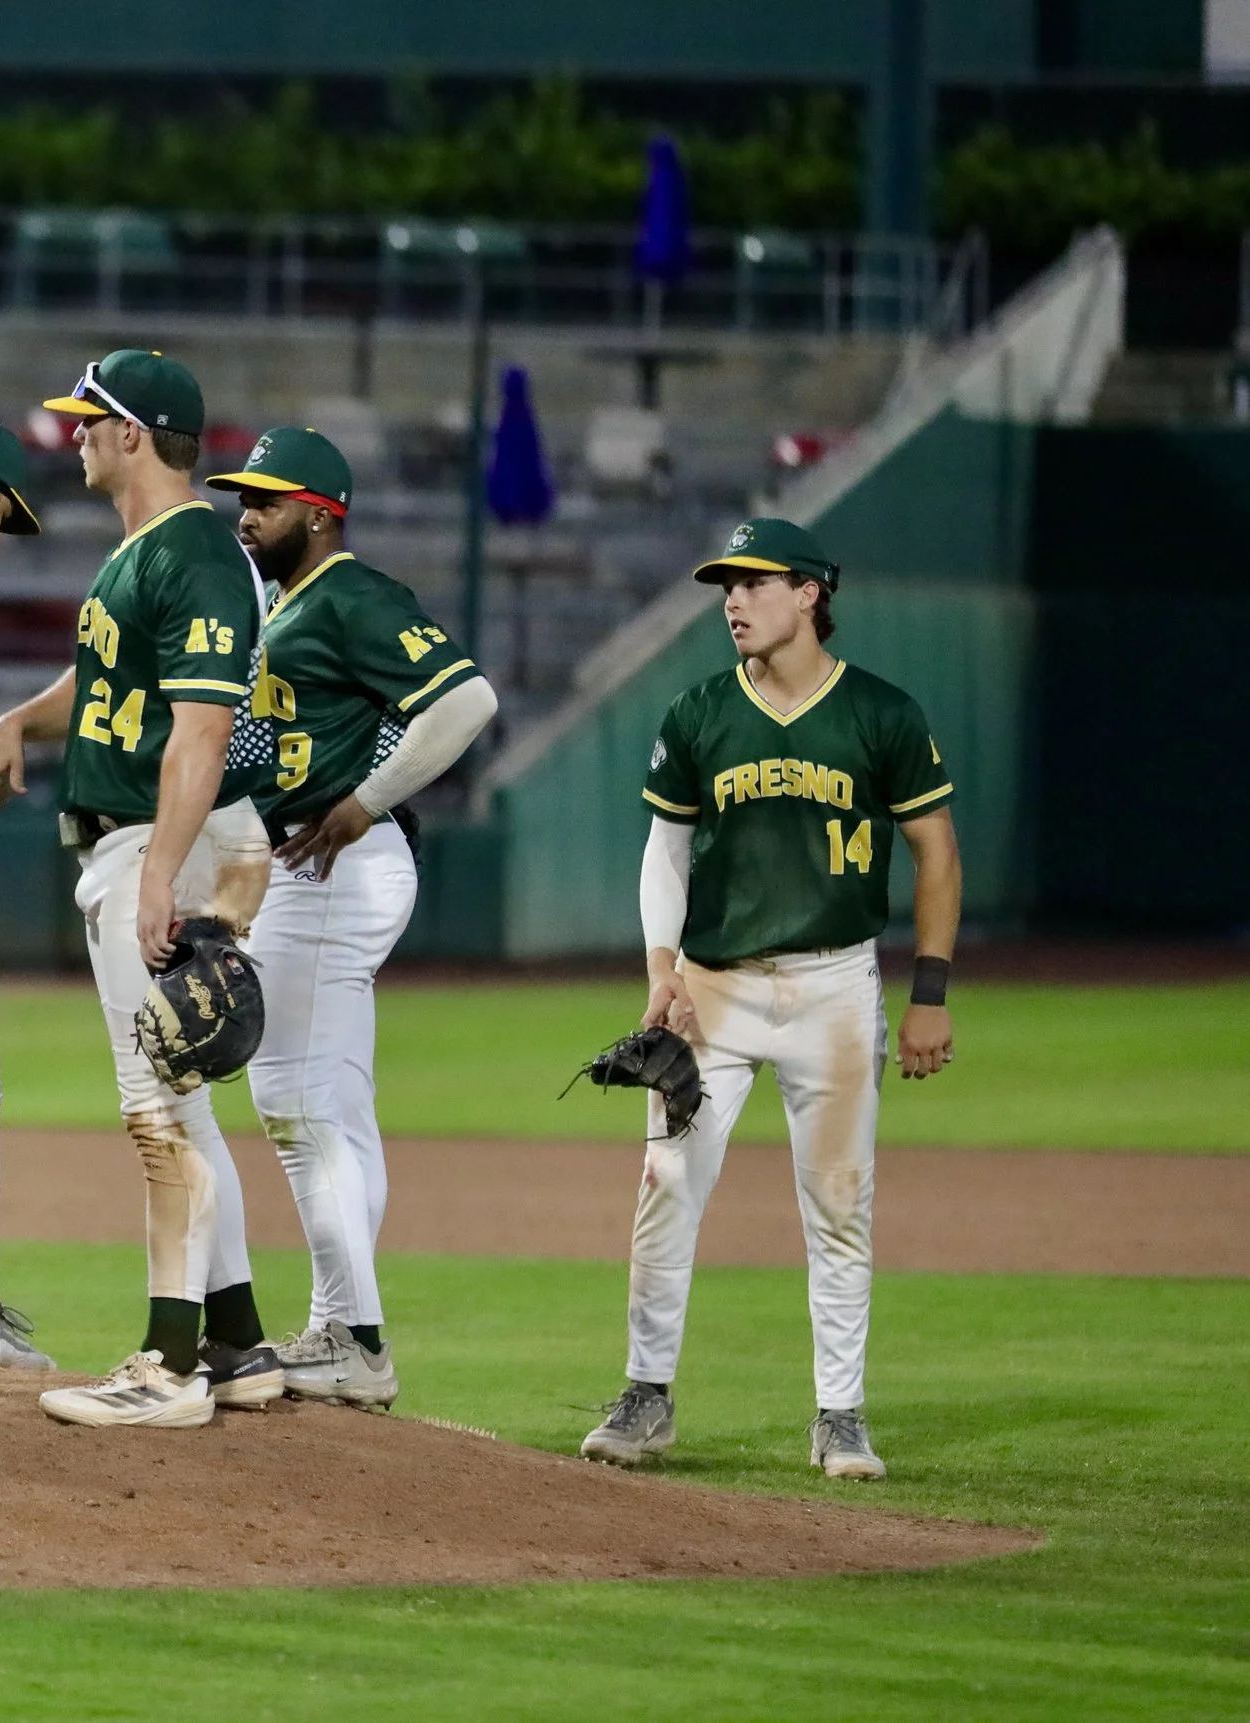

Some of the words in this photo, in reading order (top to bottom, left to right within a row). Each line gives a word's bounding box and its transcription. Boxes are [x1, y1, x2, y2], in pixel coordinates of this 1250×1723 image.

[185, 618, 234, 655] A's
[398, 626, 448, 664] A's
[79, 677, 146, 753] 24
[714, 758, 854, 813] FRESNO
[826, 819, 873, 875] 14
[183, 973, 216, 1021] Rawlings
